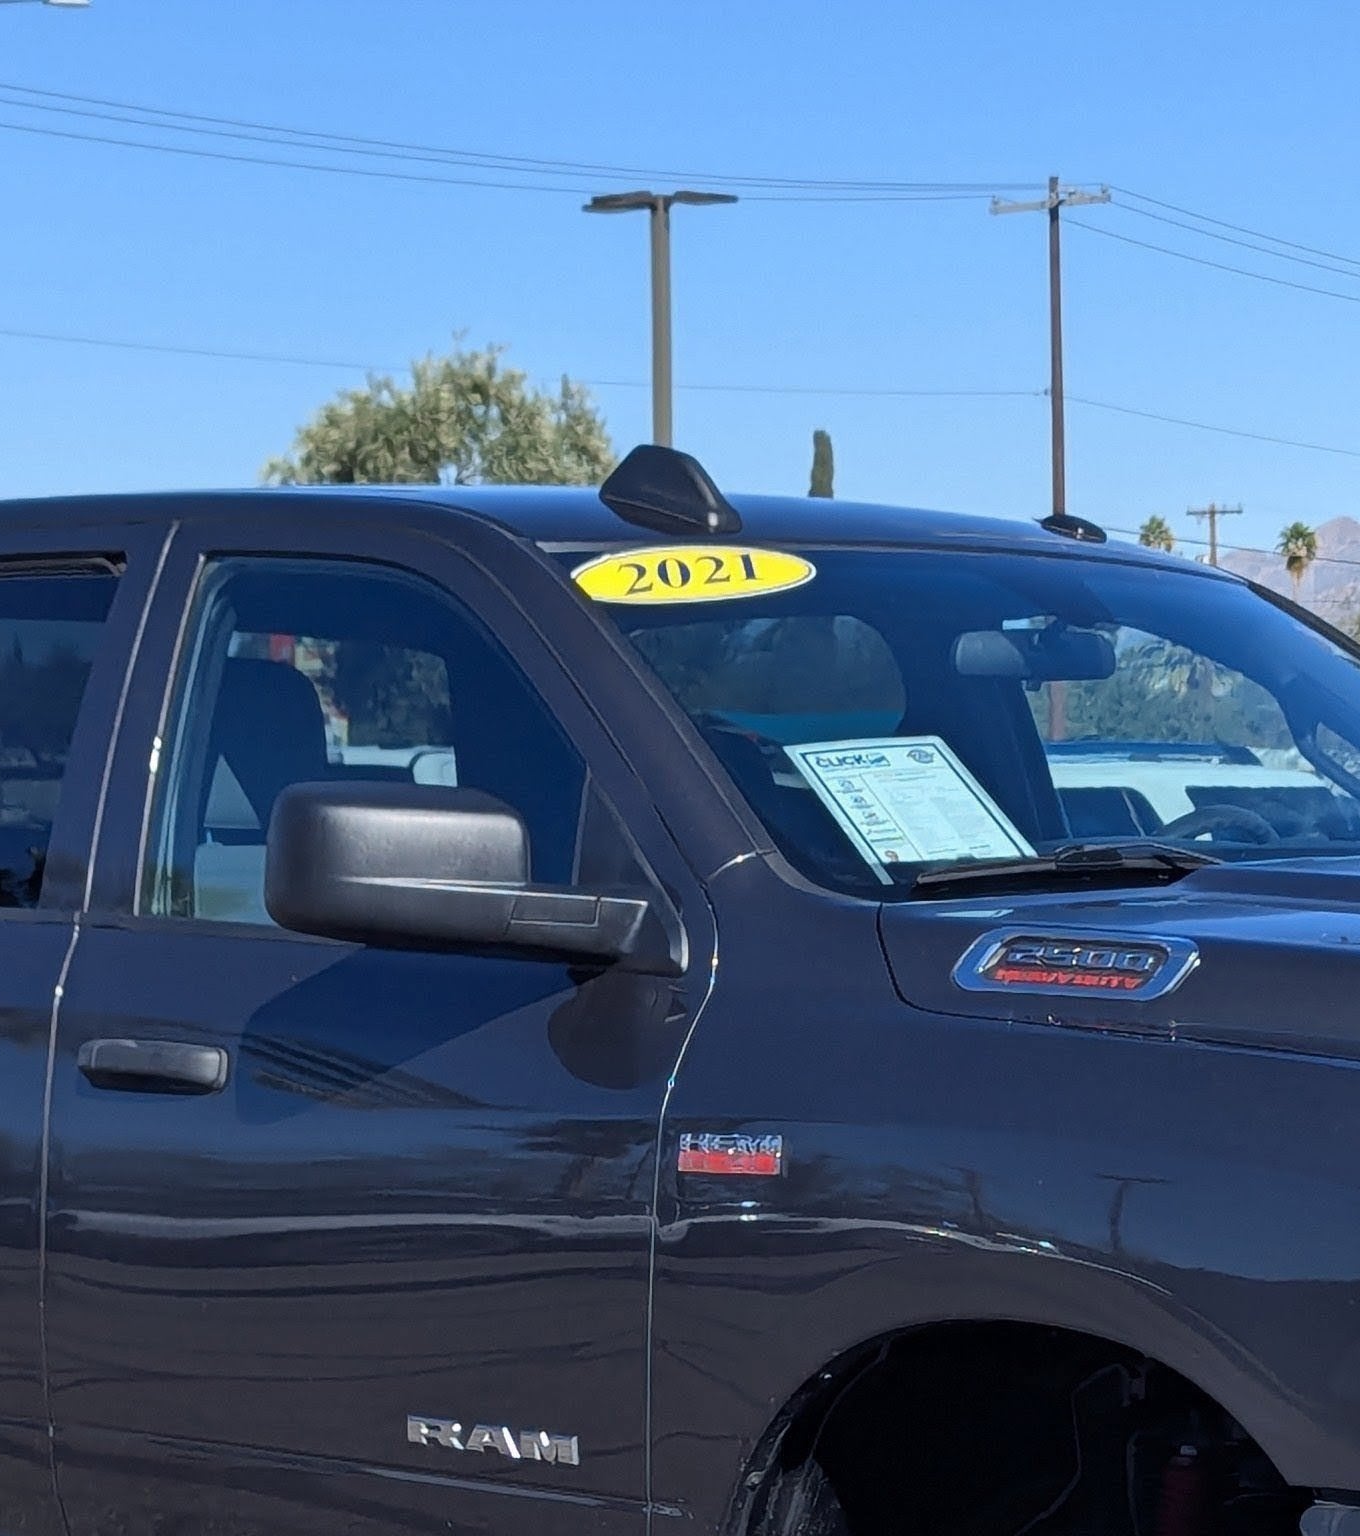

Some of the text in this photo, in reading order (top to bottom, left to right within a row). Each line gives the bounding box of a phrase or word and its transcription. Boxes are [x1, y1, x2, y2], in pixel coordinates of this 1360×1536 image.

[617, 552, 765, 596] 2021
[1005, 943, 1156, 972] 2500
[407, 1414, 580, 1466] RAM
